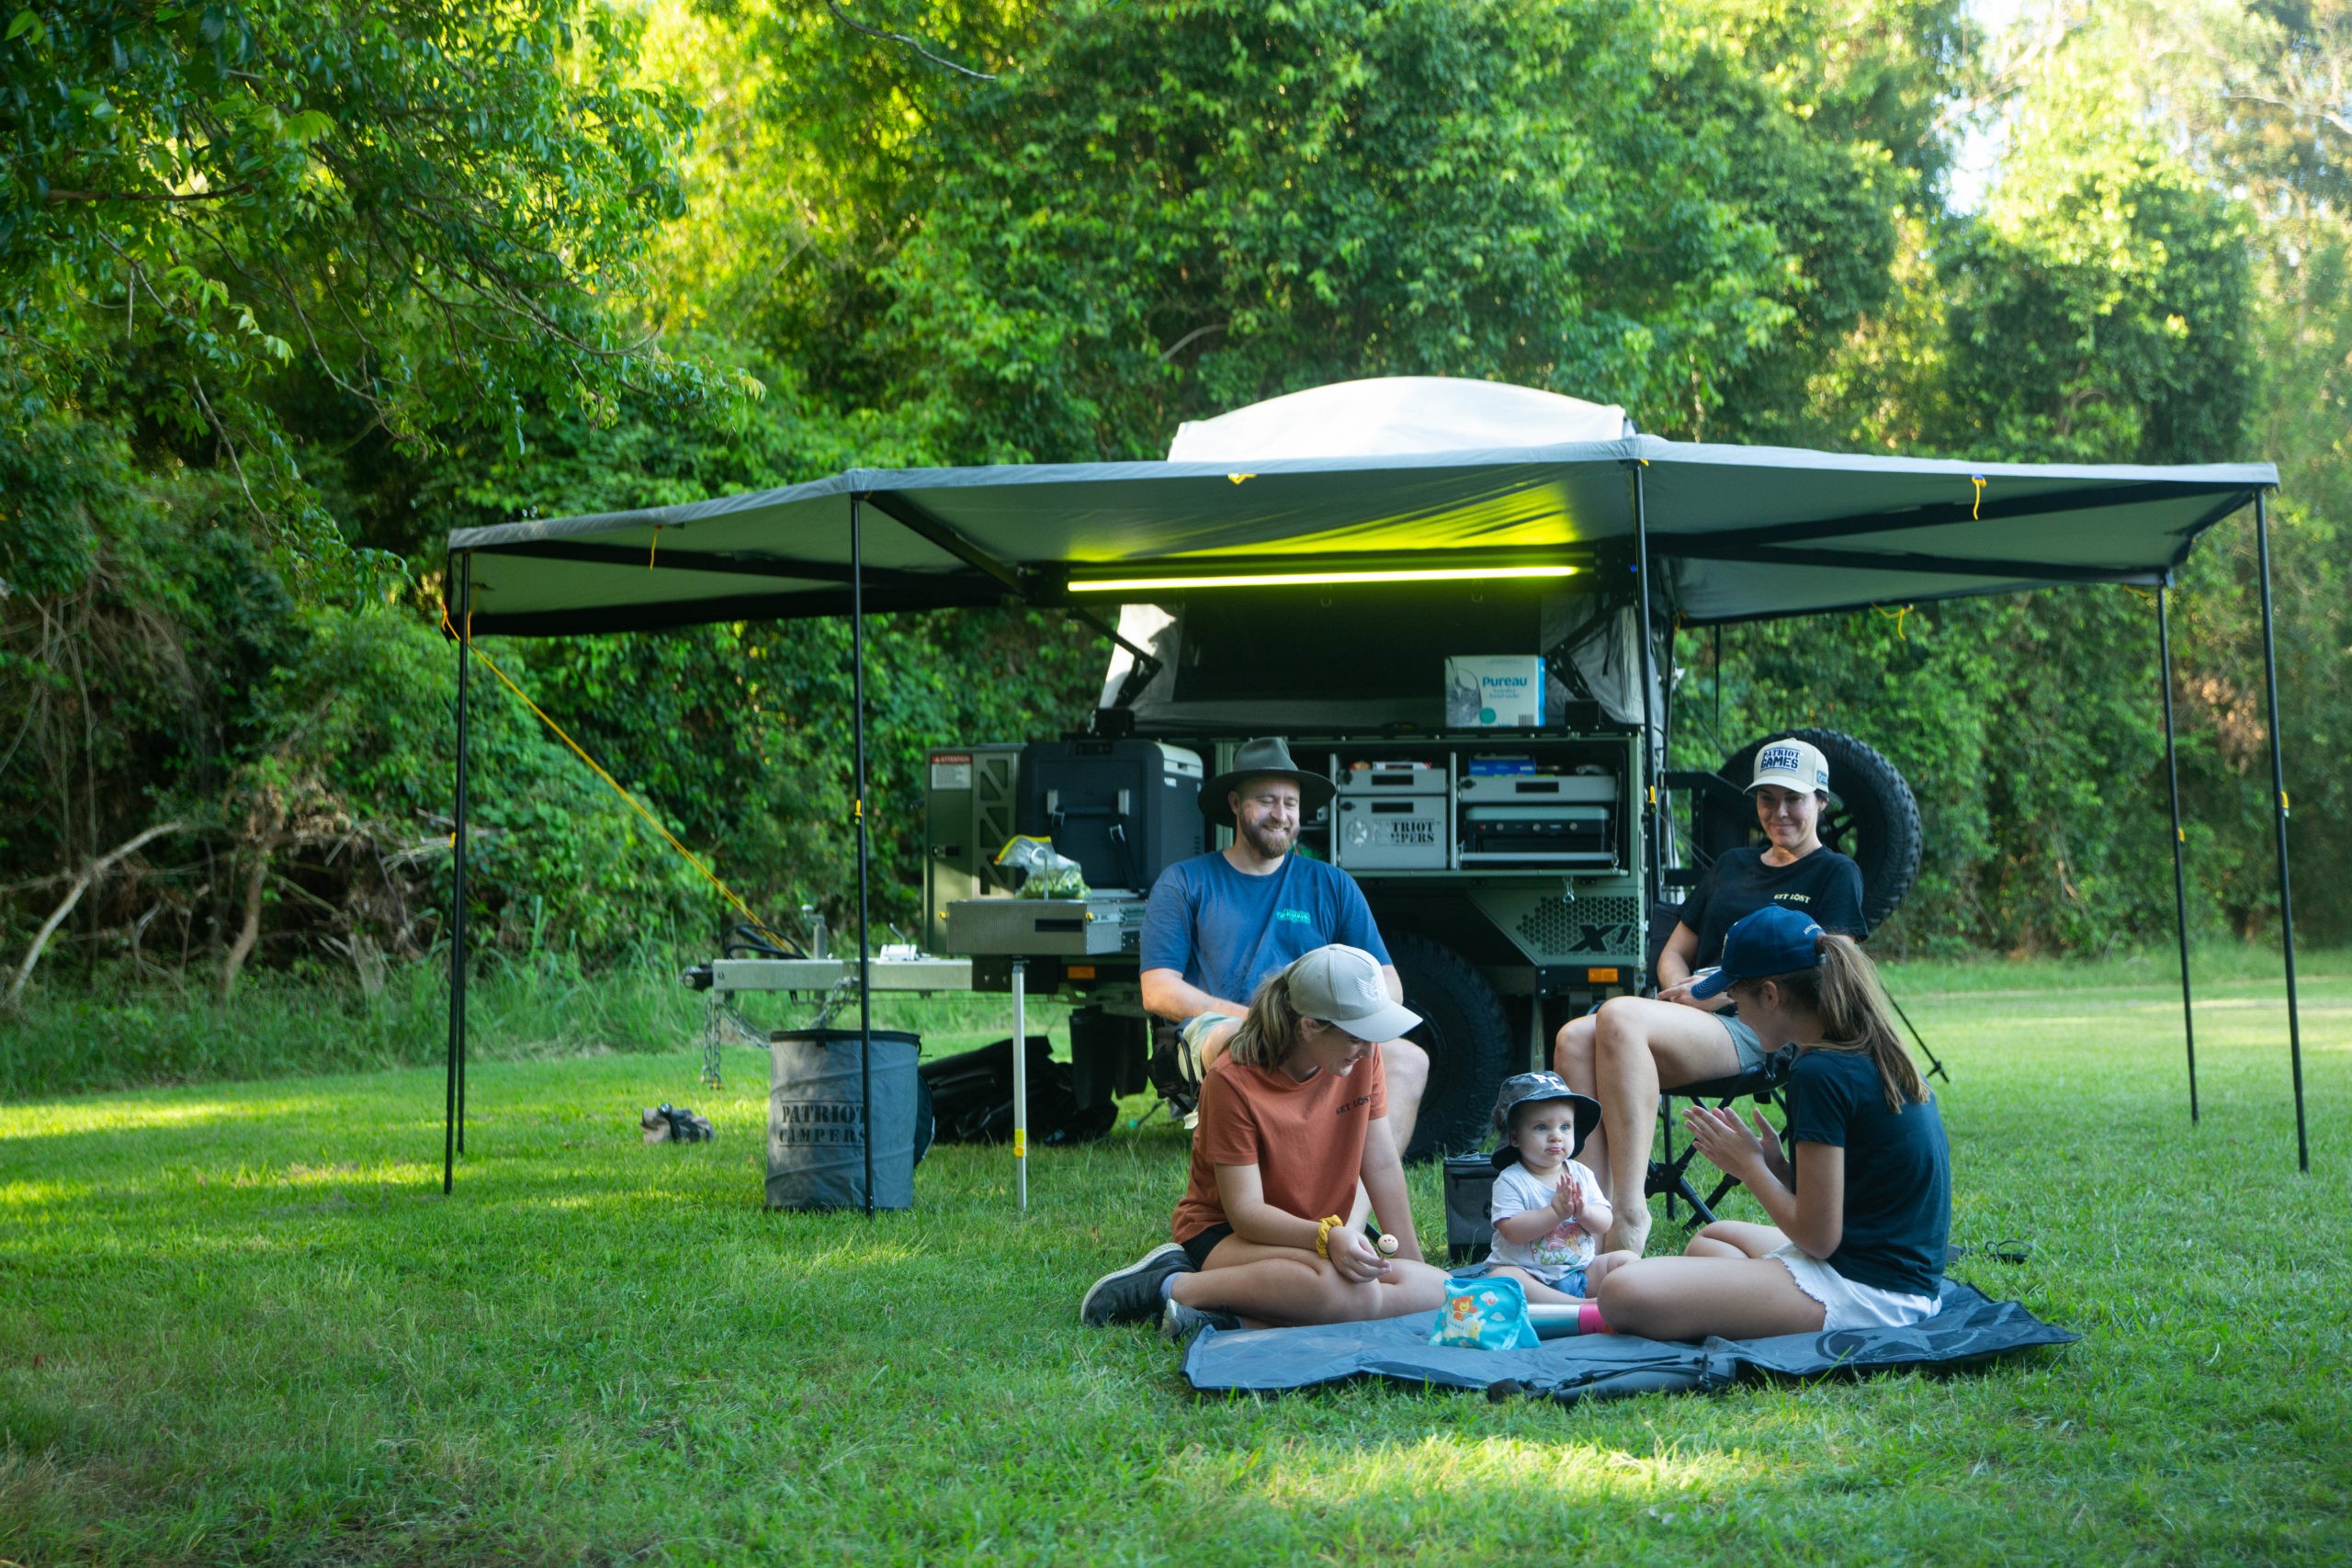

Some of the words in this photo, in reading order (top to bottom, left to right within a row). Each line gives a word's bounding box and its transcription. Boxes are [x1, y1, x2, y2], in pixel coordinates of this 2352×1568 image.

[1763, 749, 1800, 758] PATRIOT
[1761, 757, 1798, 769] GAMES
[1790, 893, 1811, 904] LOST
[1567, 924, 1633, 952] X1
[782, 1105, 865, 1123] PATRIOT
[1336, 1102, 1351, 1115] GET
